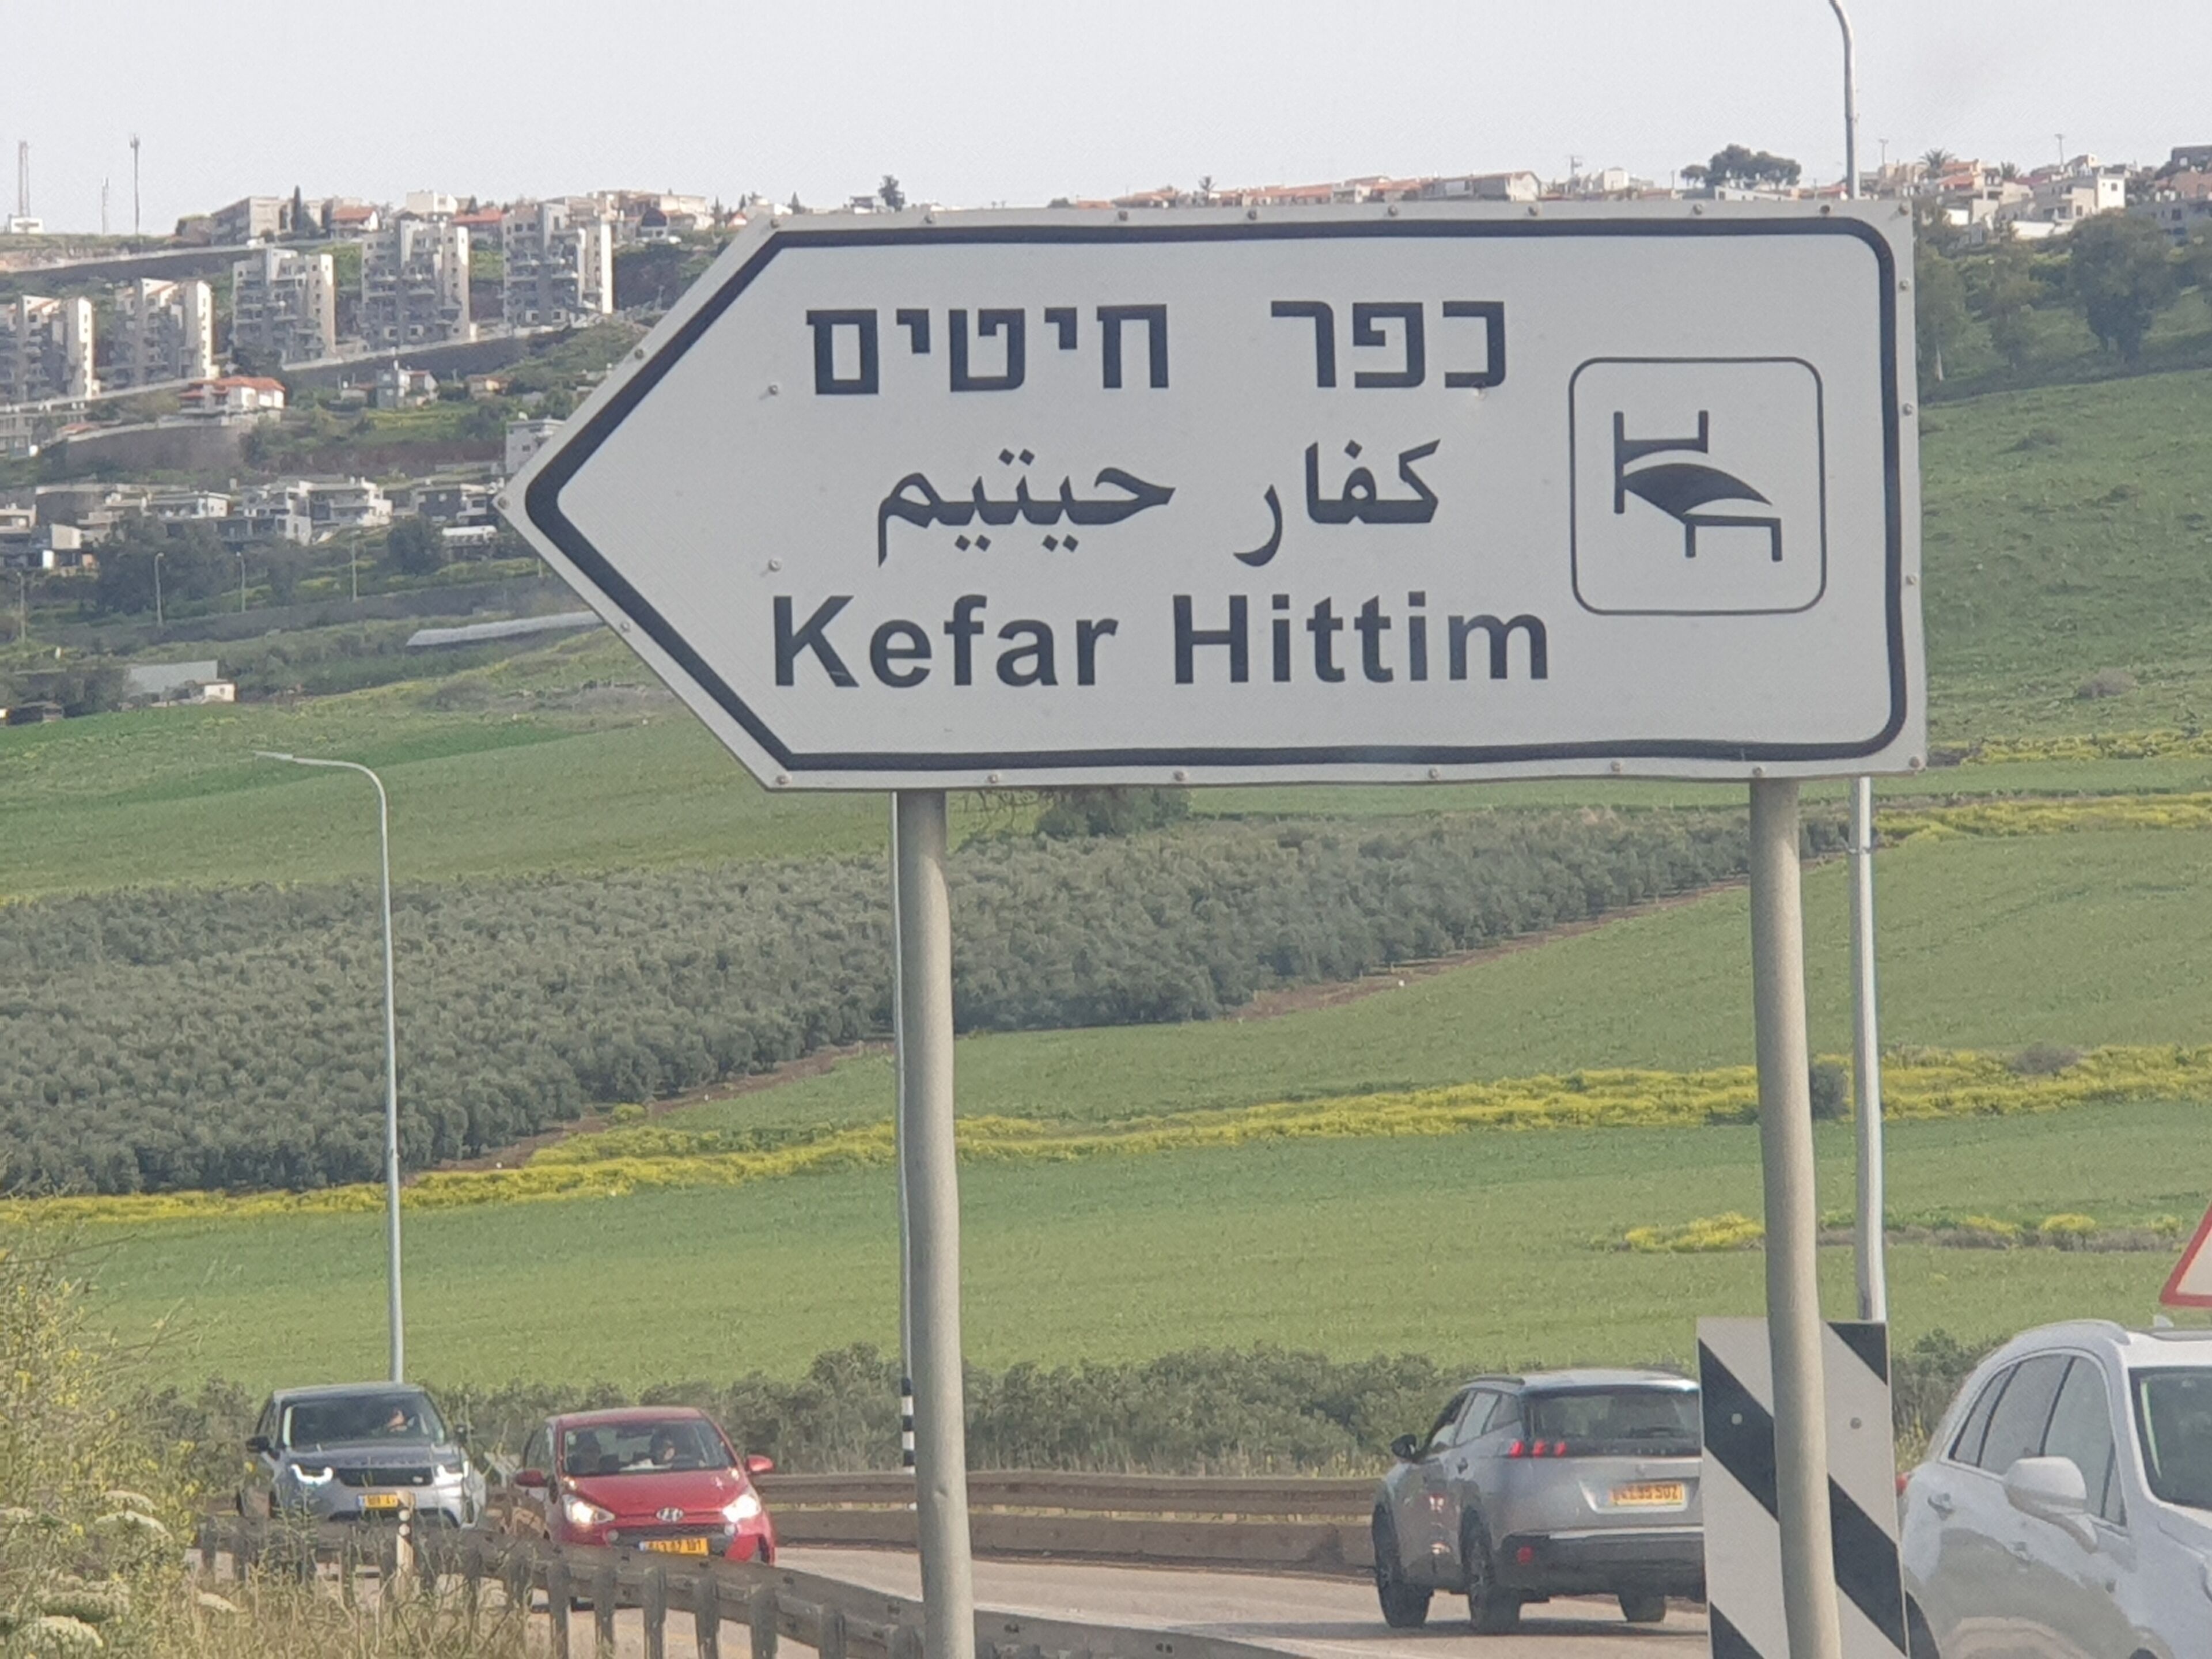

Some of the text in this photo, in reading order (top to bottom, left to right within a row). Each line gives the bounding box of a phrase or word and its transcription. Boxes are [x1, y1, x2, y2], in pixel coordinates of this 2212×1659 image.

[806, 301, 1506, 395] כפר חיטים
[878, 439, 1441, 567] كفار حيتيم
[772, 591, 1548, 688] Kefar Hittim
